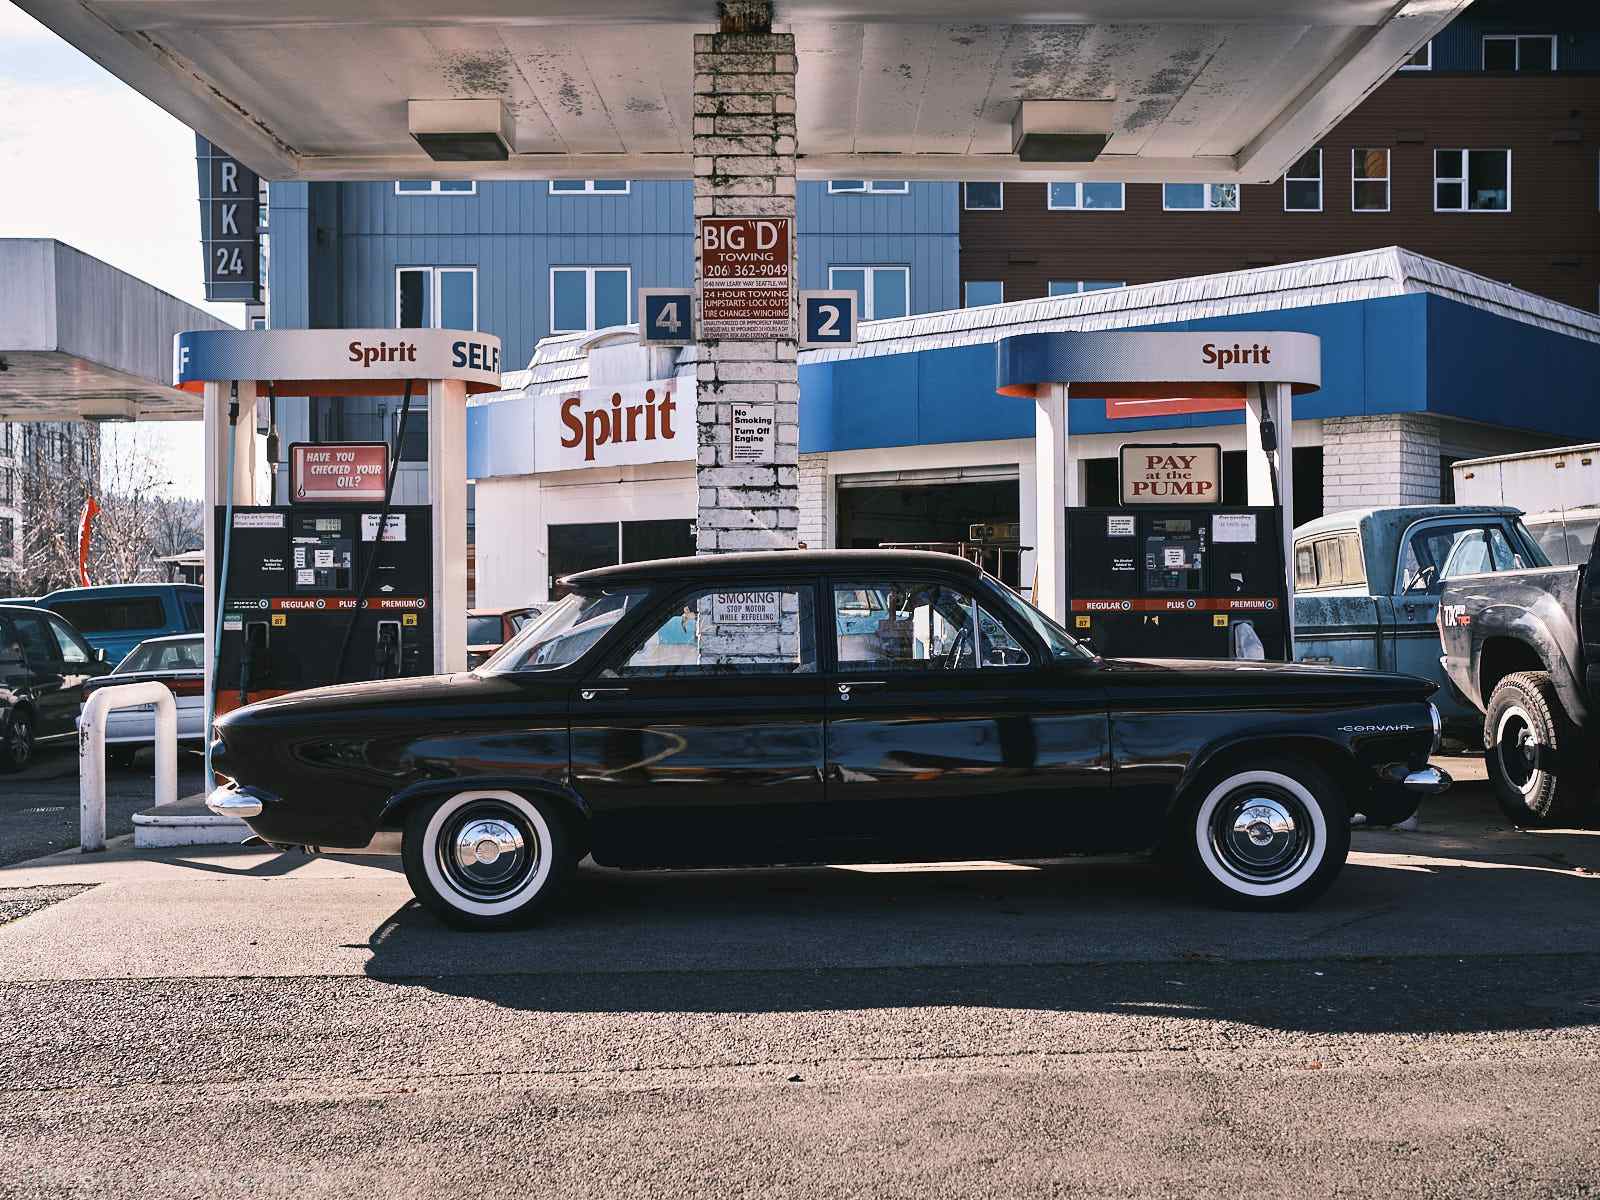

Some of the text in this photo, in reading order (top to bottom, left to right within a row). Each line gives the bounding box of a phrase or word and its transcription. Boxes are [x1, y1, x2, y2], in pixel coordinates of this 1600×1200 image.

[703, 226, 745, 250] BIG
[216, 248, 243, 275] 24
[718, 252, 774, 262] TOWING
[734, 264, 788, 276] 362-9049
[704, 290, 789, 298] 24 HOUR TOWING
[655, 302, 682, 333] 4
[817, 305, 841, 336] 2
[348, 341, 417, 368] Spirit
[1202, 343, 1272, 370] Spirit
[560, 388, 677, 461] Spirit
[734, 416, 772, 425] Smoking
[734, 427, 770, 435] Turn Off
[734, 435, 764, 443] Engine
[306, 452, 355, 462] HAVE YOU
[1145, 455, 1197, 470] PAY
[310, 464, 382, 475] CHECKED YOUR
[1145, 470, 1192, 480] at the
[336, 476, 362, 488] OIL?
[1131, 481, 1213, 496] PUMP
[717, 592, 775, 604] SMOKING
[281, 600, 315, 609] REGULAR
[339, 600, 357, 608] PLUS
[381, 600, 417, 608] PREMIUM
[1086, 601, 1120, 609] REGULAR
[1166, 601, 1185, 609] PLUS
[1230, 600, 1265, 608] PREMIUM
[719, 613, 738, 621] WHILE
[1341, 724, 1412, 732] CORVAIR
